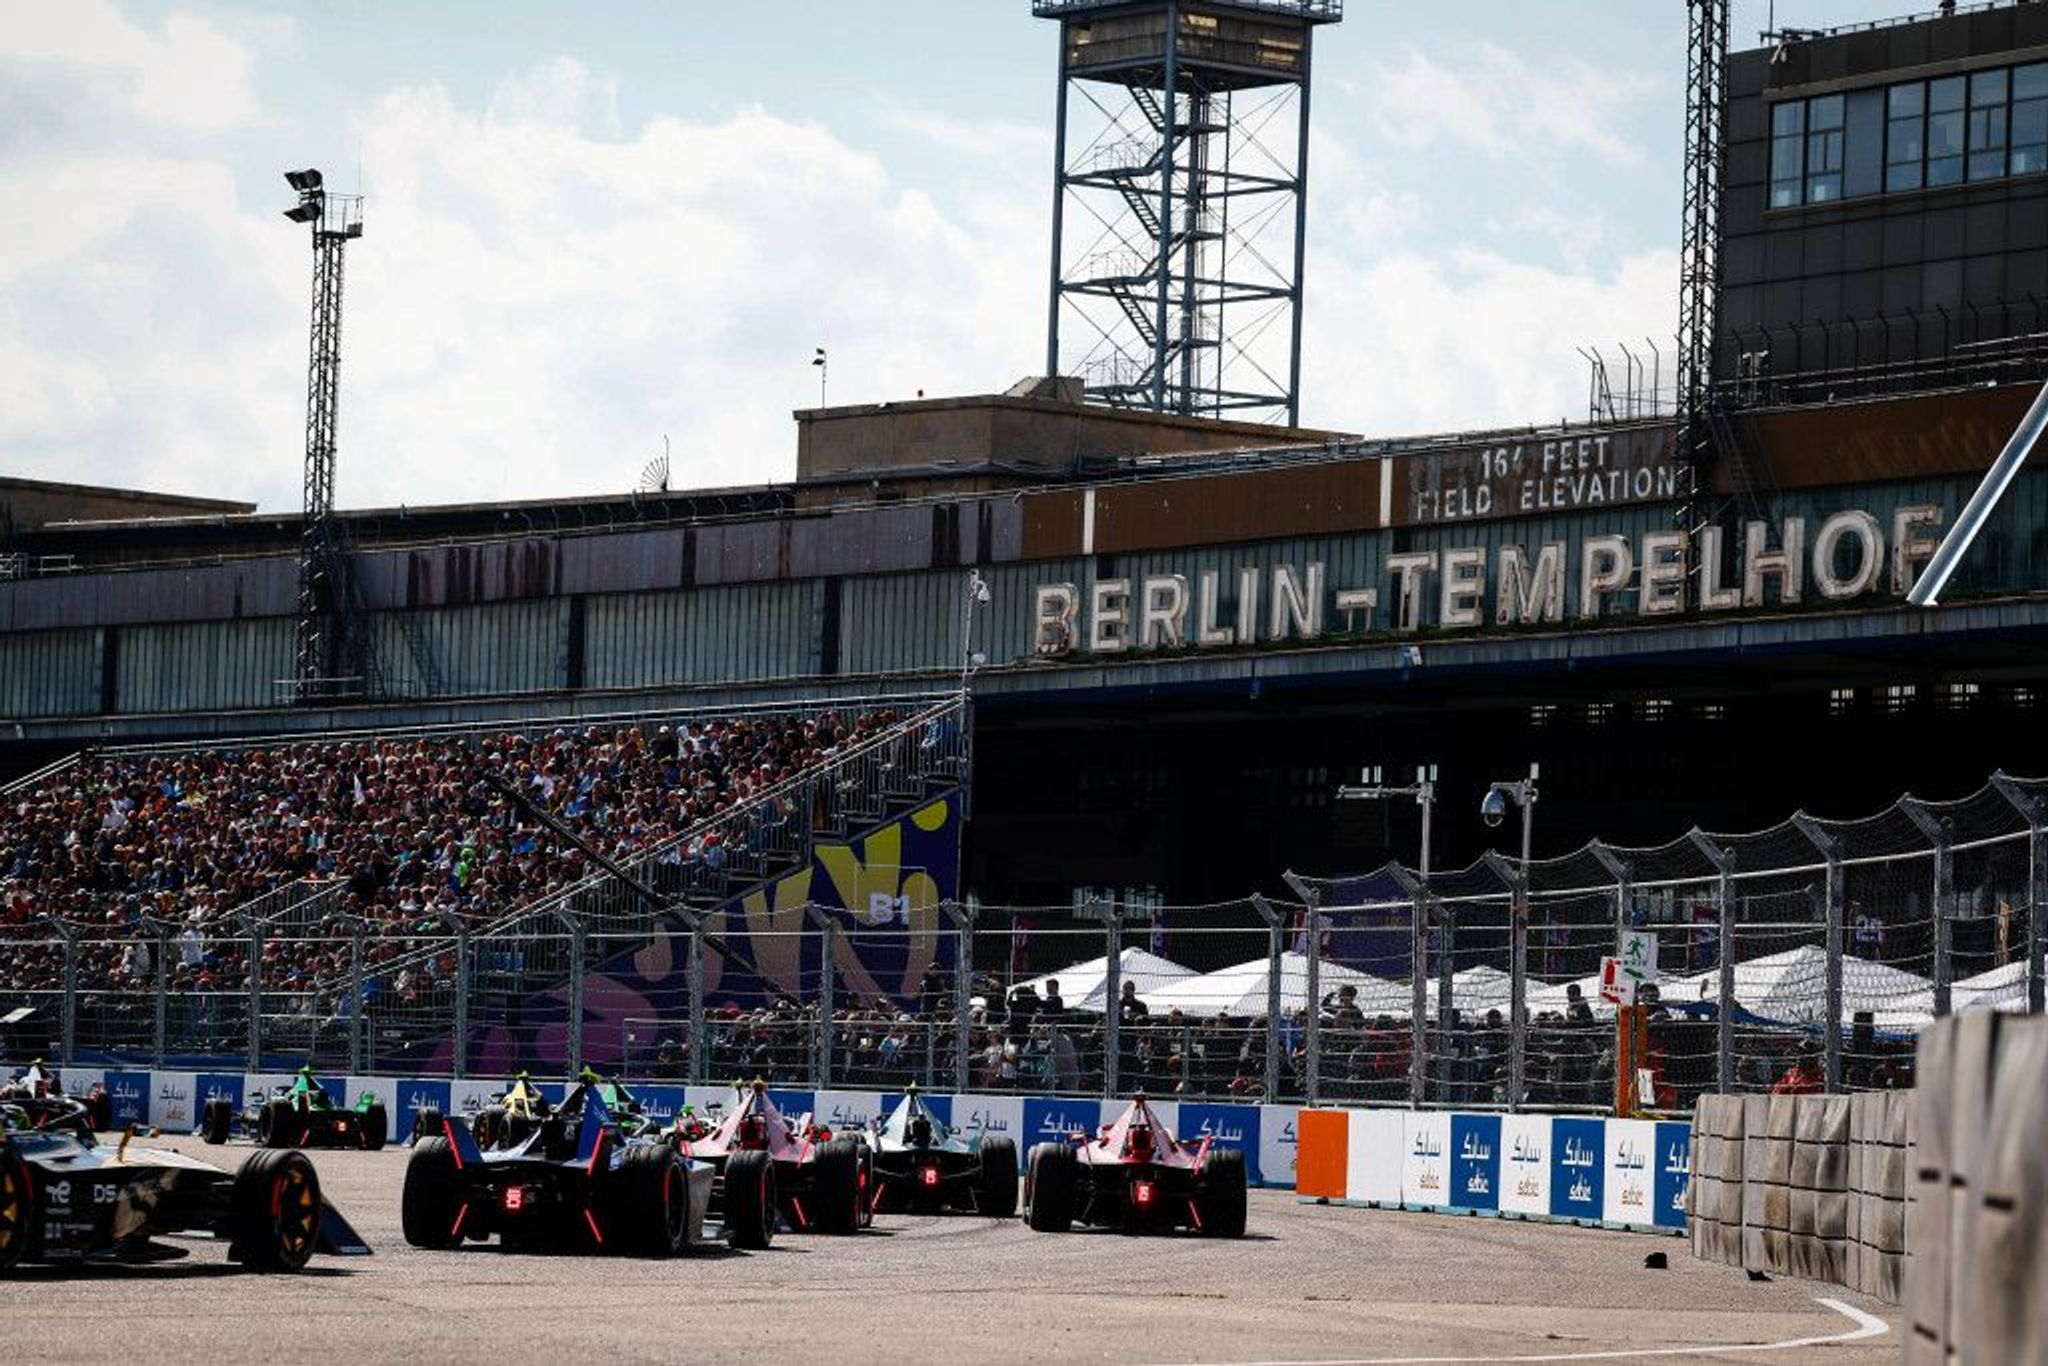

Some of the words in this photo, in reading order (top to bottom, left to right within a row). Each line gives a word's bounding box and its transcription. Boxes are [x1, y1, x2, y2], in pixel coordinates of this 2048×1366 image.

[1542, 437, 1609, 473] FEET
[1414, 484, 1492, 520] FIELD
[1520, 465, 1676, 510] ELEVATION
[93, 1184, 117, 1203] DS
